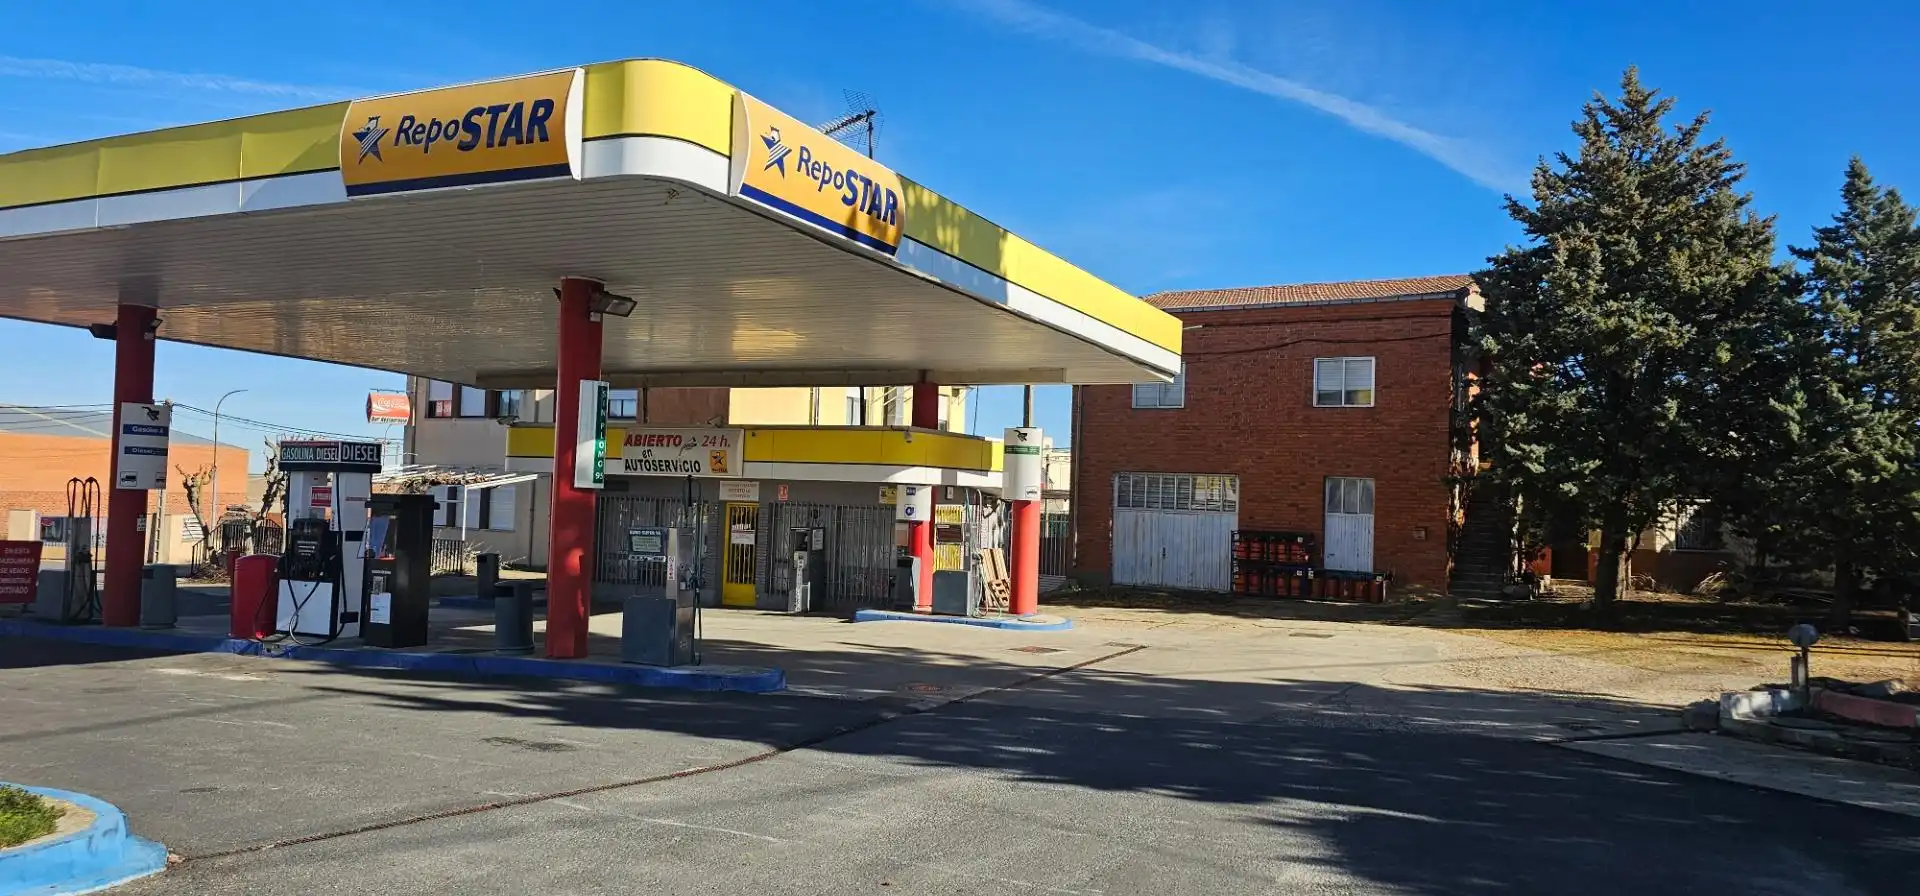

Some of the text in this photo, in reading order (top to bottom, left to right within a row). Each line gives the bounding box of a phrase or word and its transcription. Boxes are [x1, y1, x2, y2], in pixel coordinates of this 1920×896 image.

[394, 98, 555, 154] RepoSTAR
[796, 145, 898, 226] RepoSTAR
[624, 434, 682, 447] ABIERTO
[701, 435, 717, 447] 24
[281, 447, 338, 461] GASOLINA DIESEL
[343, 444, 379, 462] DIESEL
[642, 448, 653, 458] en
